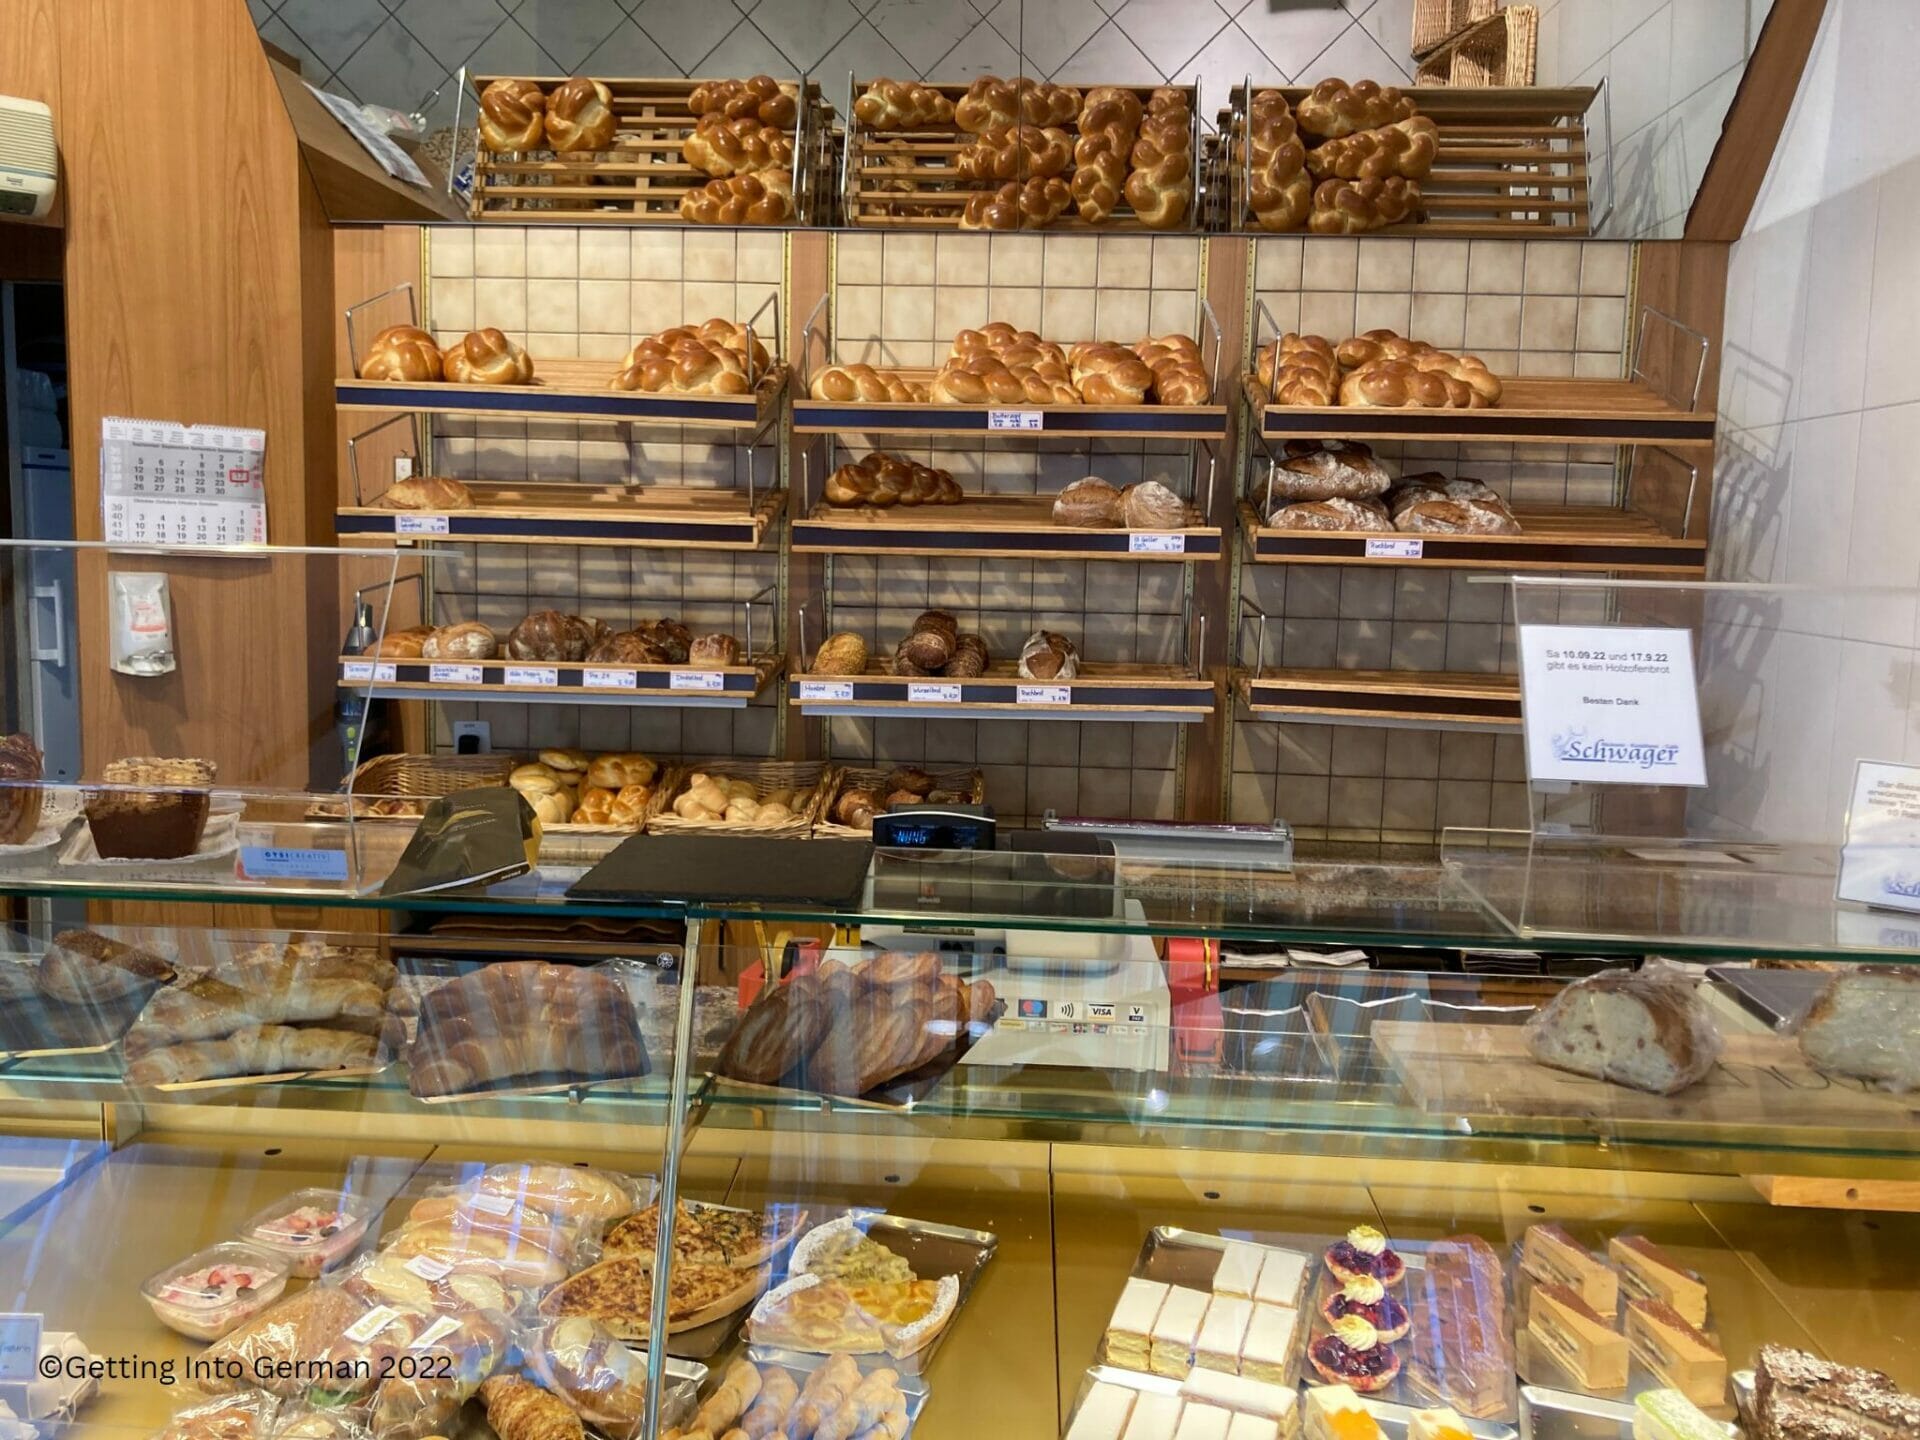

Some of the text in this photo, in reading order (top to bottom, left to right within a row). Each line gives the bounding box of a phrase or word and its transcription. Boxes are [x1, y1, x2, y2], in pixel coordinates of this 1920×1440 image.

[138, 457, 143, 465] 5
[1546, 650, 1669, 662] Sa 10.09.22 und 17.9.22
[1546, 661, 1670, 674] gibt es kein Holzofenbrot
[1582, 696, 1640, 706] Besten Dank
[1568, 739, 1680, 769] Schwager
[1093, 1008, 1112, 1016] VISA
